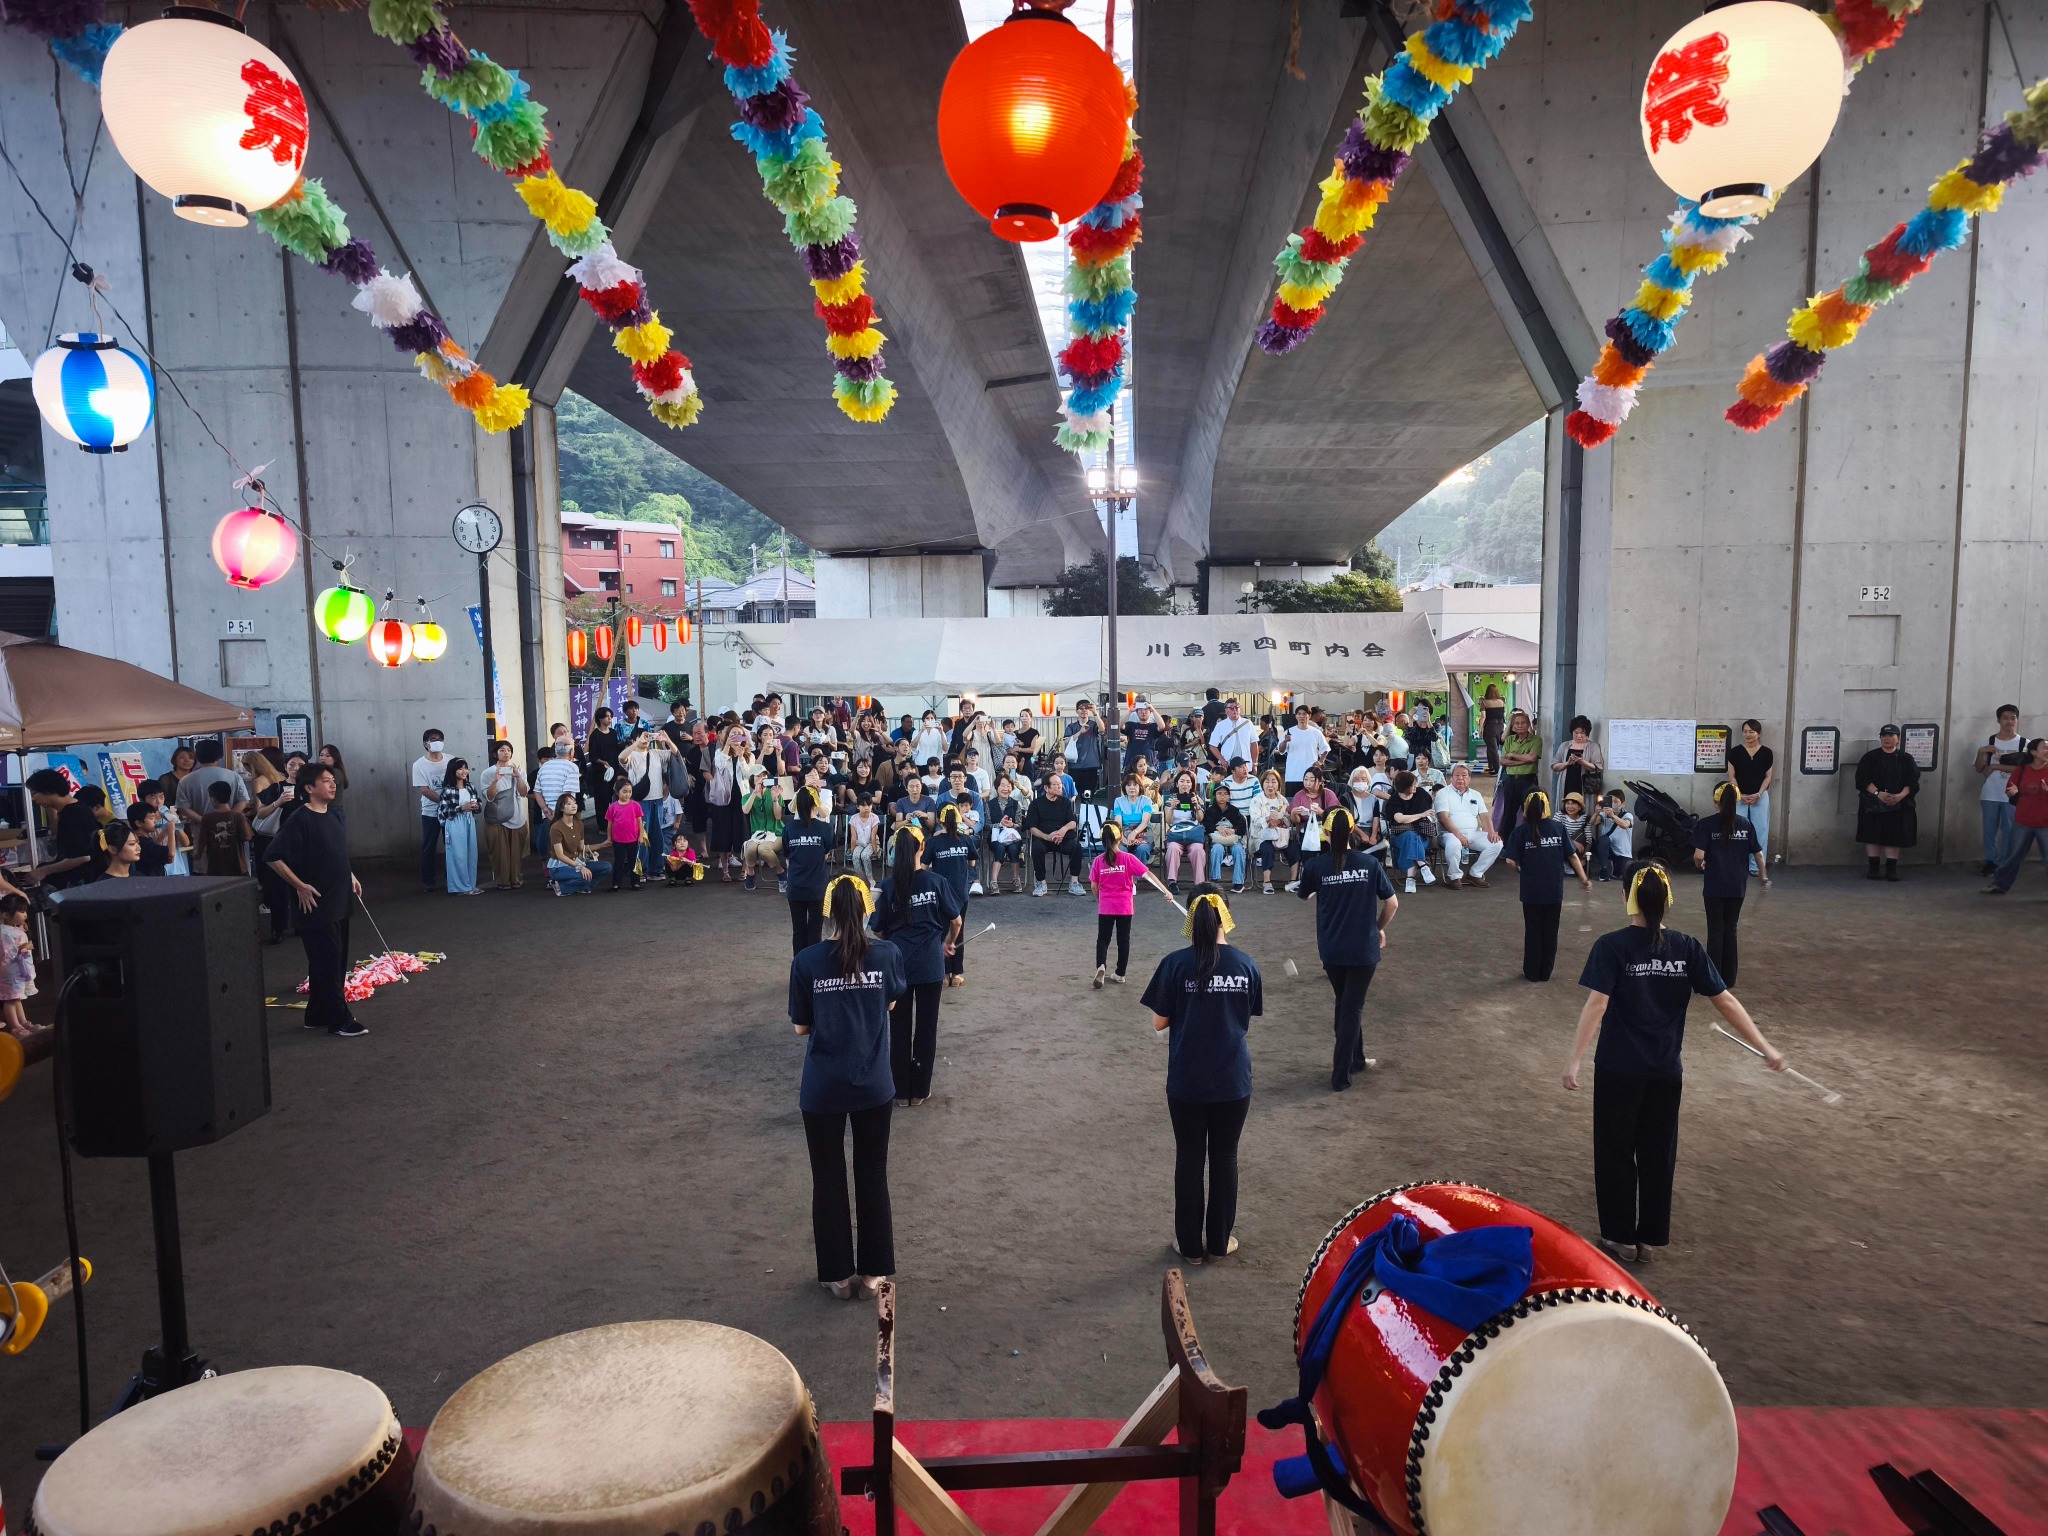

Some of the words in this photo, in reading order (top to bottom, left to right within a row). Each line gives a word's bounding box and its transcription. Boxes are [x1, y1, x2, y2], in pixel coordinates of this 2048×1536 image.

[1645, 31, 1731, 154] 祭
[1861, 587, 1869, 601] P
[1873, 587, 1890, 601] 5-2
[228, 621, 235, 633] P
[238, 621, 253, 633] 5-1
[1146, 636, 1387, 657] 川島第四町内会
[573, 690, 589, 742] 杉山神社
